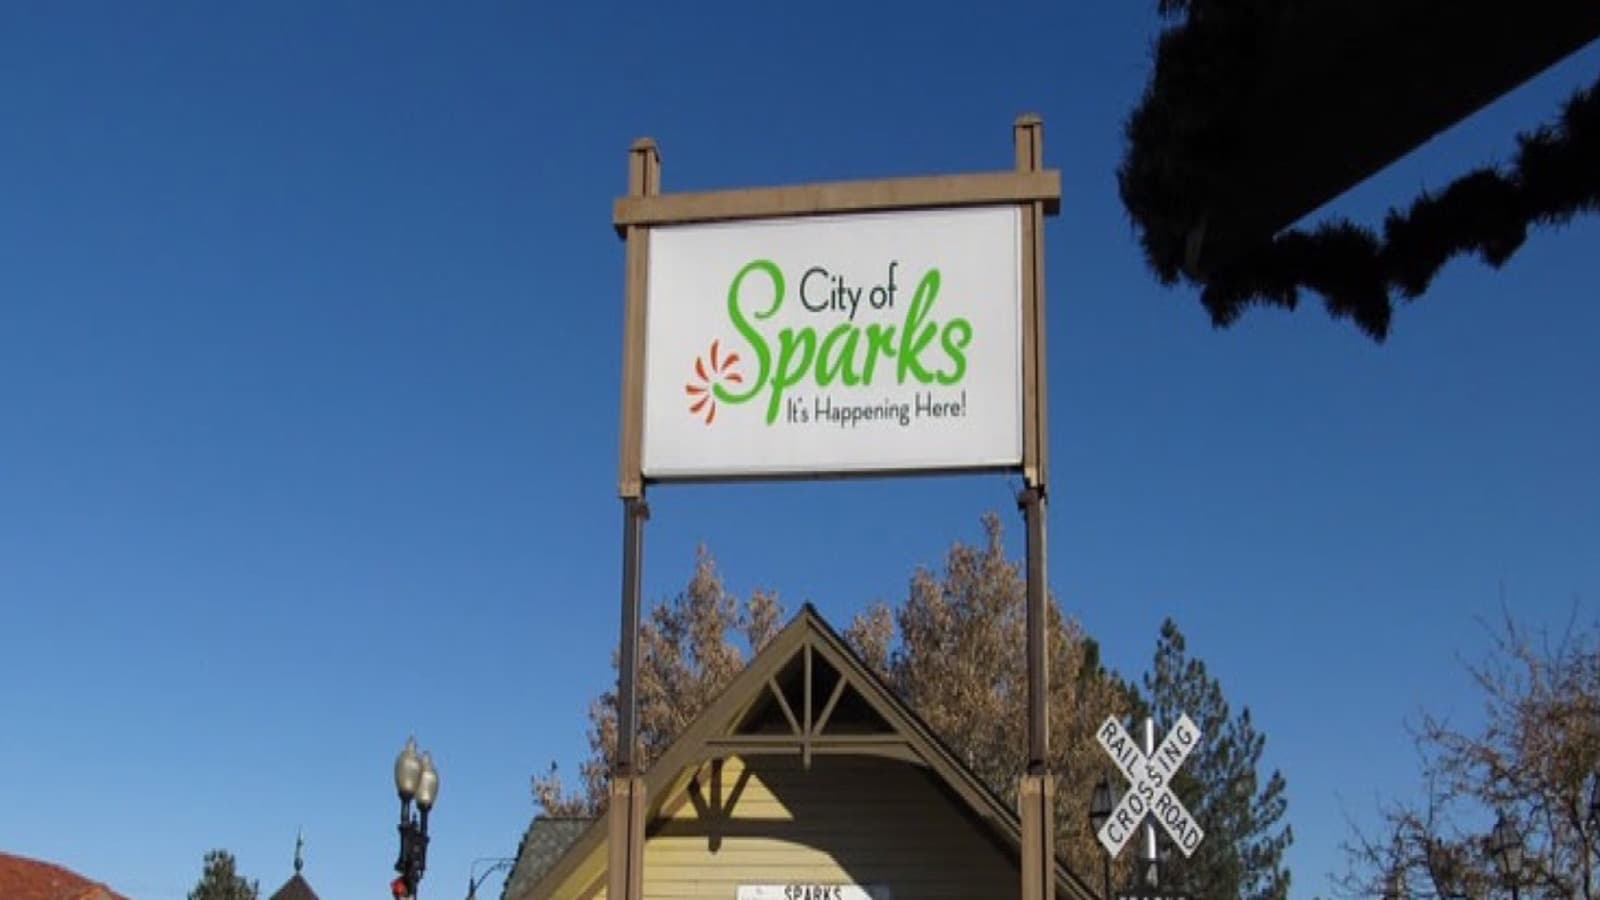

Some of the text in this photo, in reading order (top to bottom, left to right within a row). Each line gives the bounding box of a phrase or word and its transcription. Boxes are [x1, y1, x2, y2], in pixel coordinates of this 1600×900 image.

[800, 260, 898, 320] City of
[712, 259, 973, 426] Sparks
[786, 391, 966, 427] It's Happening Here!
[1102, 722, 1139, 779] RAIL
[1106, 725, 1192, 844] CROSSING
[1154, 792, 1199, 850] ROAD
[784, 886, 842, 900] SPARKS
